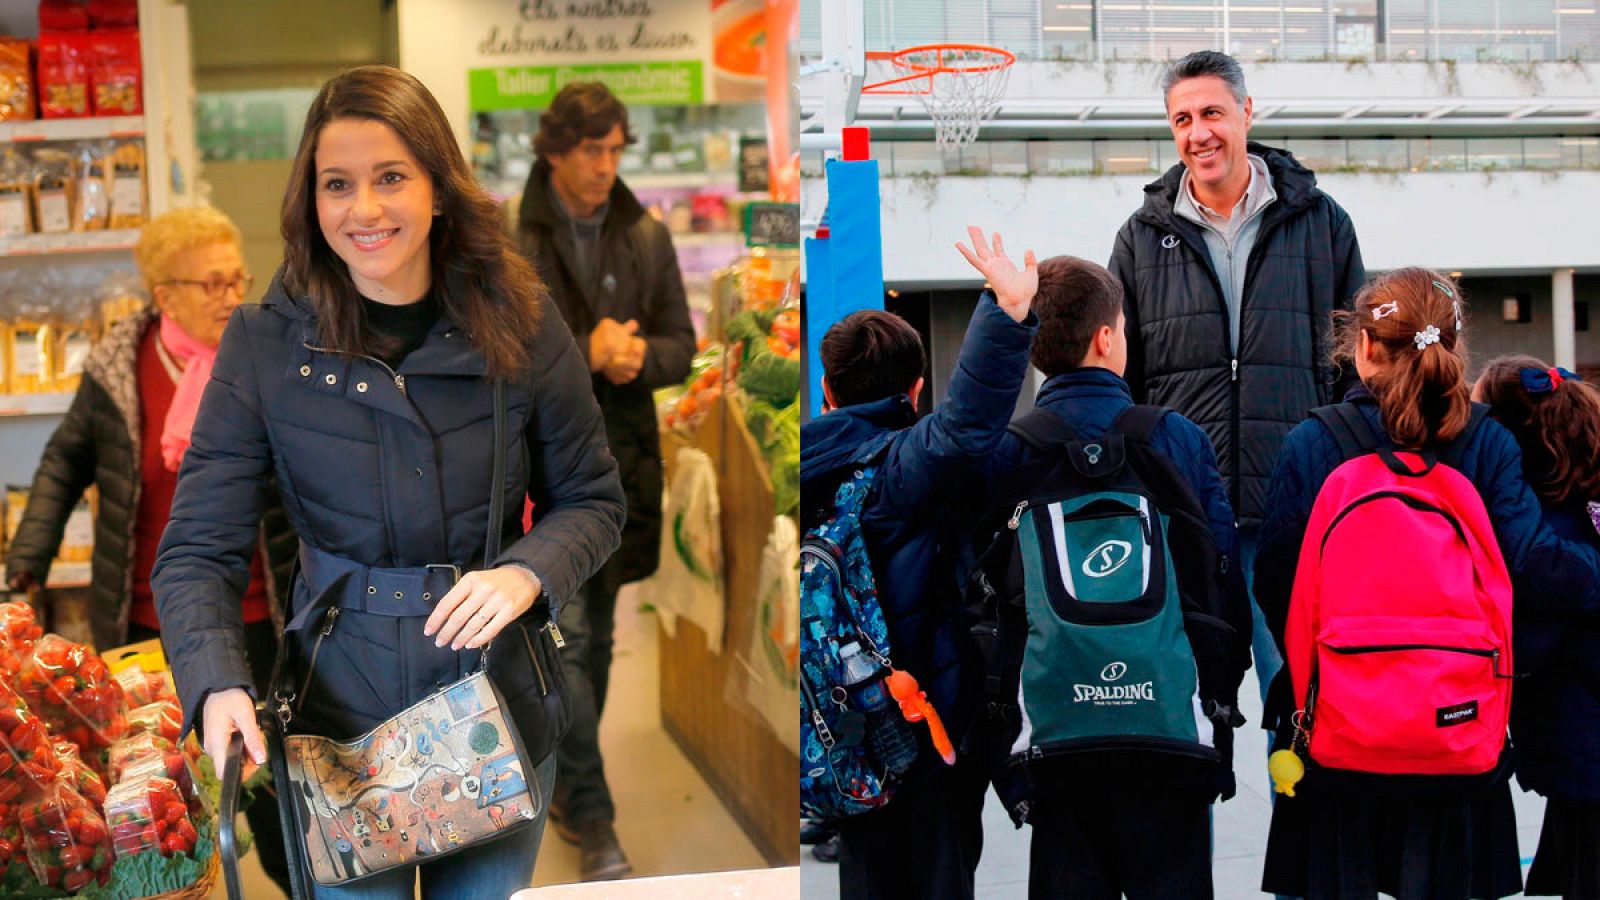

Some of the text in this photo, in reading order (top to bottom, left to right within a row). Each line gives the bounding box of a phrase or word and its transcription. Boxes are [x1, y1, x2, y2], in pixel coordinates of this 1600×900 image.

[495, 69, 550, 96] Taller
[1073, 681, 1156, 701] SPALDING
[1443, 707, 1474, 720] EASTPAK
